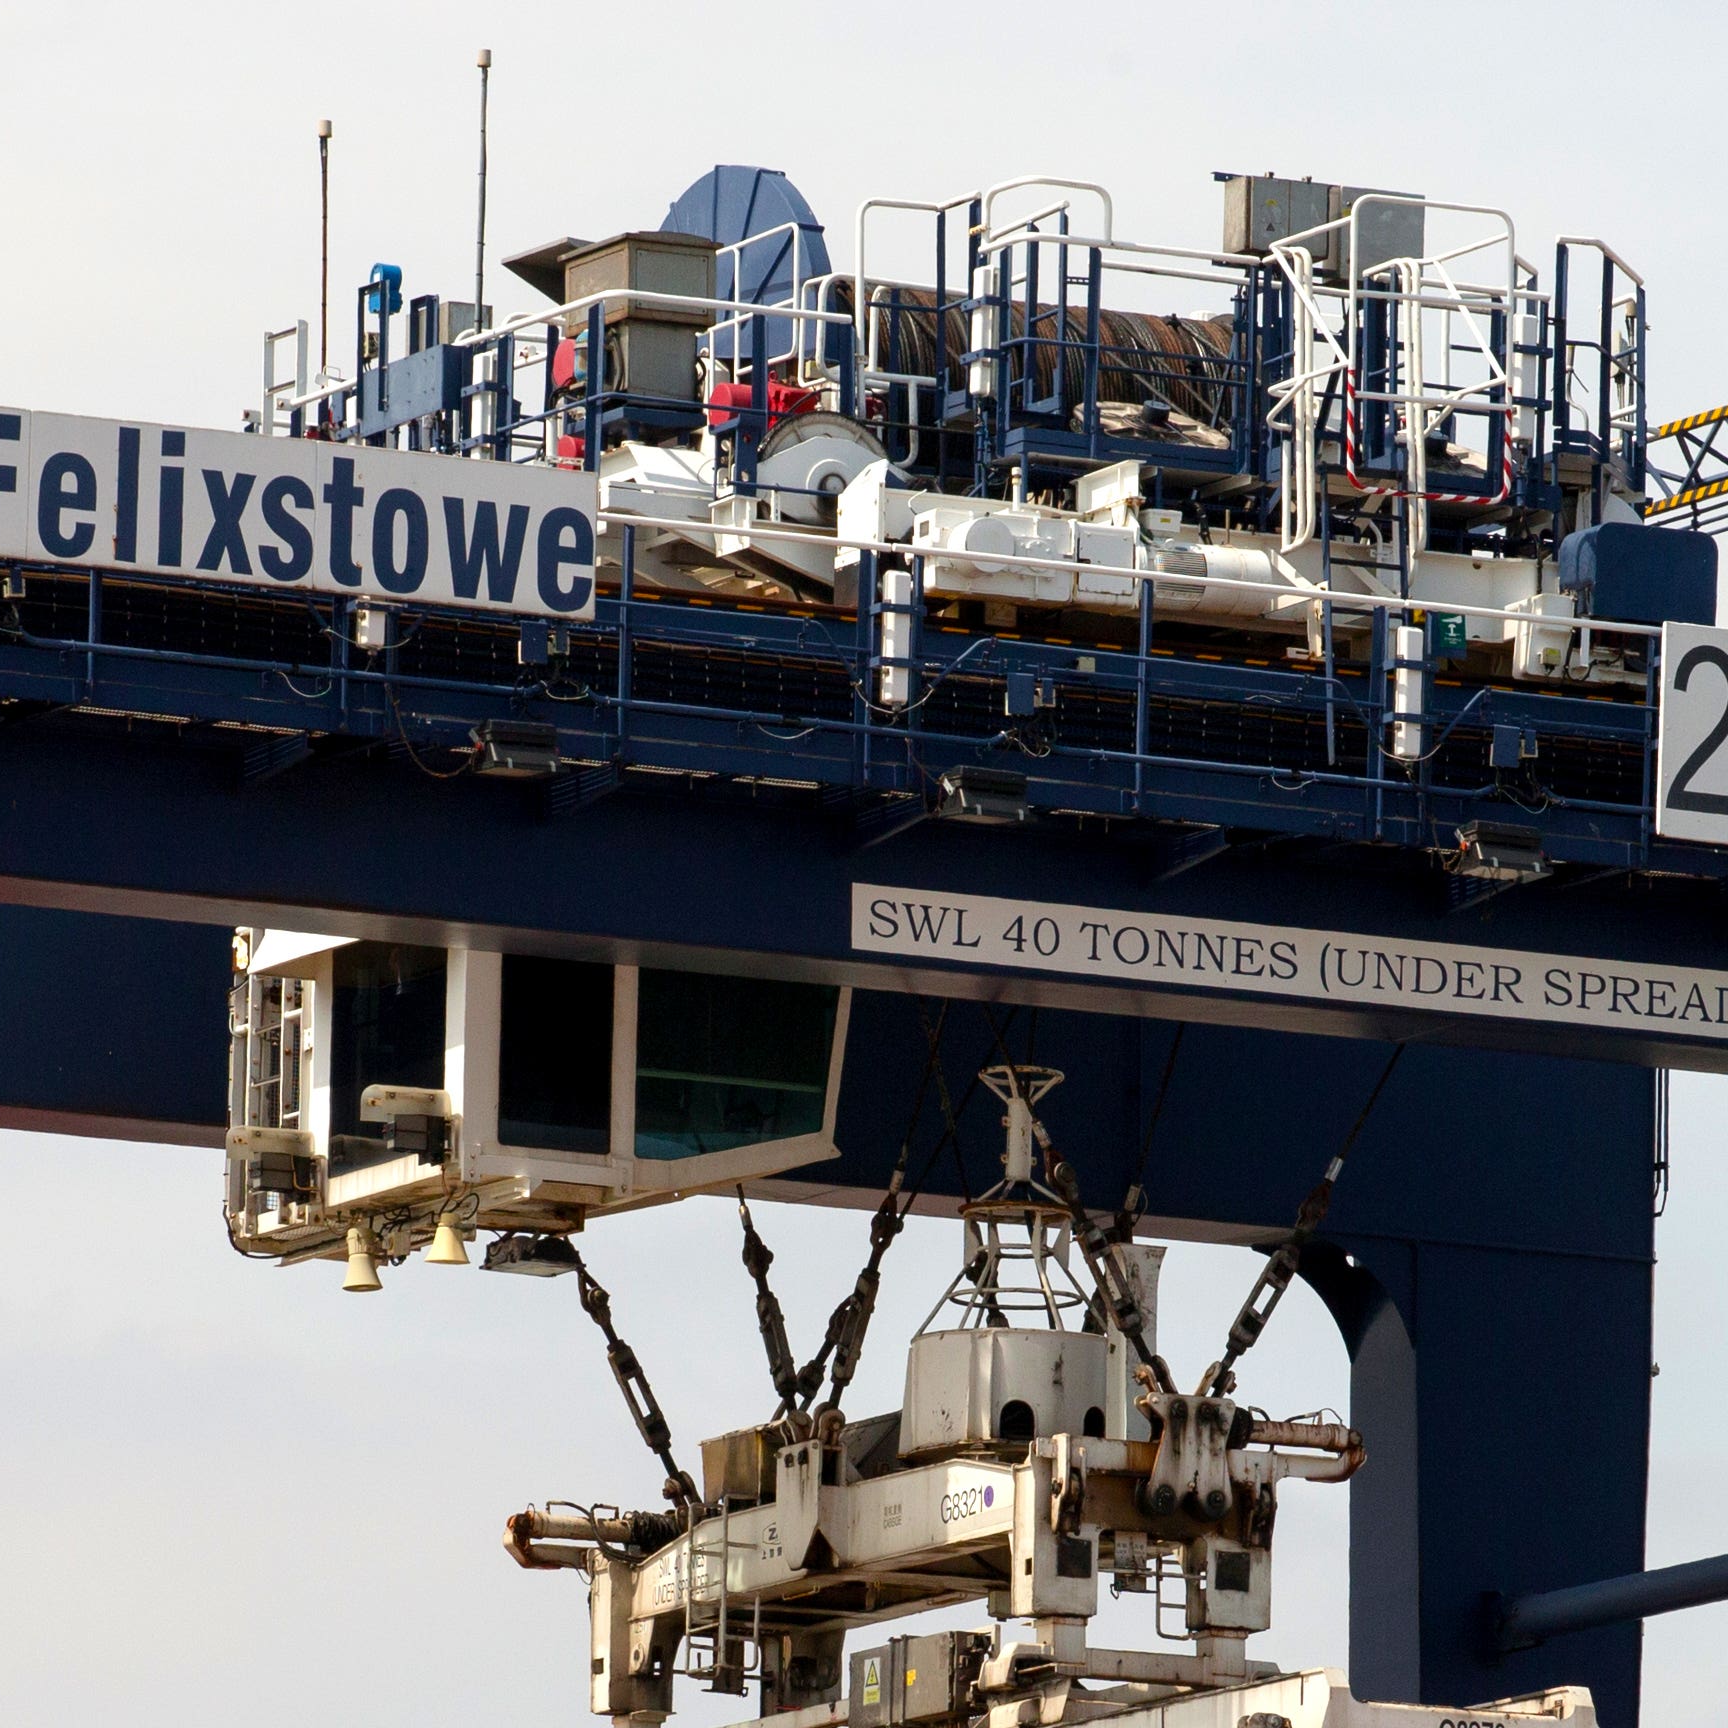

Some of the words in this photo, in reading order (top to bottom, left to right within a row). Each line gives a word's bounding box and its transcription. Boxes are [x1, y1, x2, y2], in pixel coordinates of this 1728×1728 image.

[868, 899, 981, 950] SWL
[1002, 915, 1061, 957] 40
[1080, 920, 1299, 982] TONNES
[1318, 941, 1524, 1007] (UNDER
[940, 1484, 983, 1525] G8321
